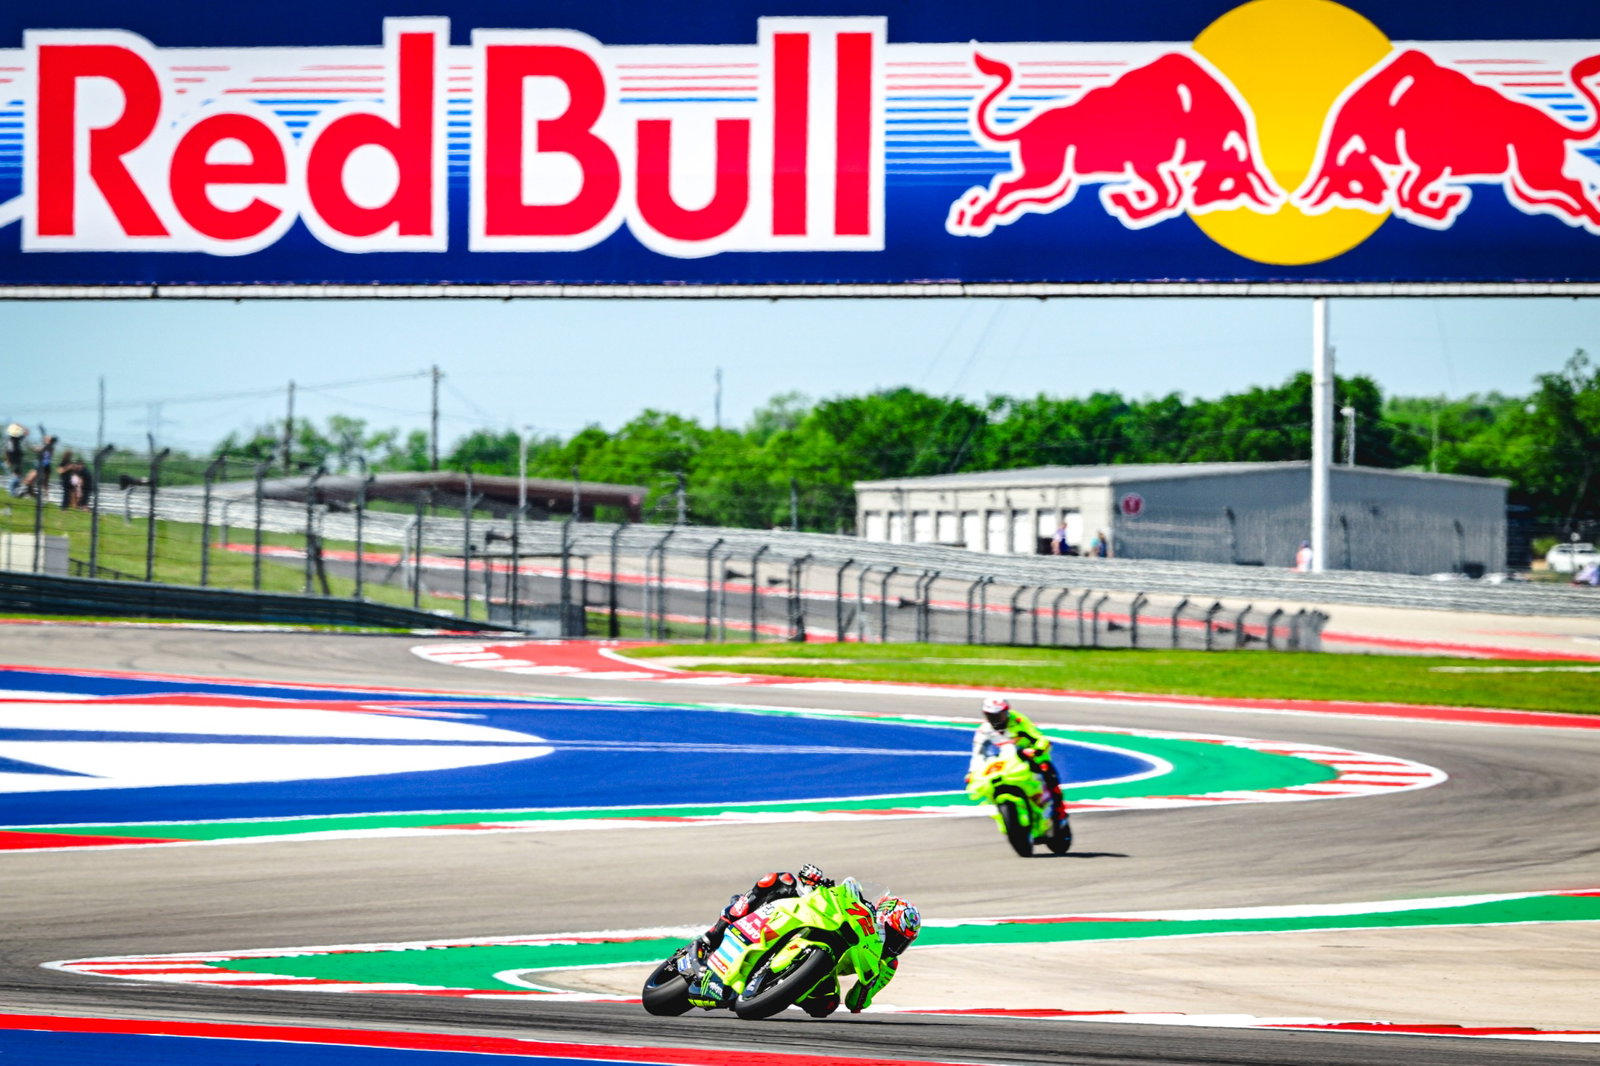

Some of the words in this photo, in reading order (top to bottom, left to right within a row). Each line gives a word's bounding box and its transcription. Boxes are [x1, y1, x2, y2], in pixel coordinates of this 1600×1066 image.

[34, 30, 436, 242] Red
[483, 30, 874, 243] Bull
[845, 901, 876, 937] 72
